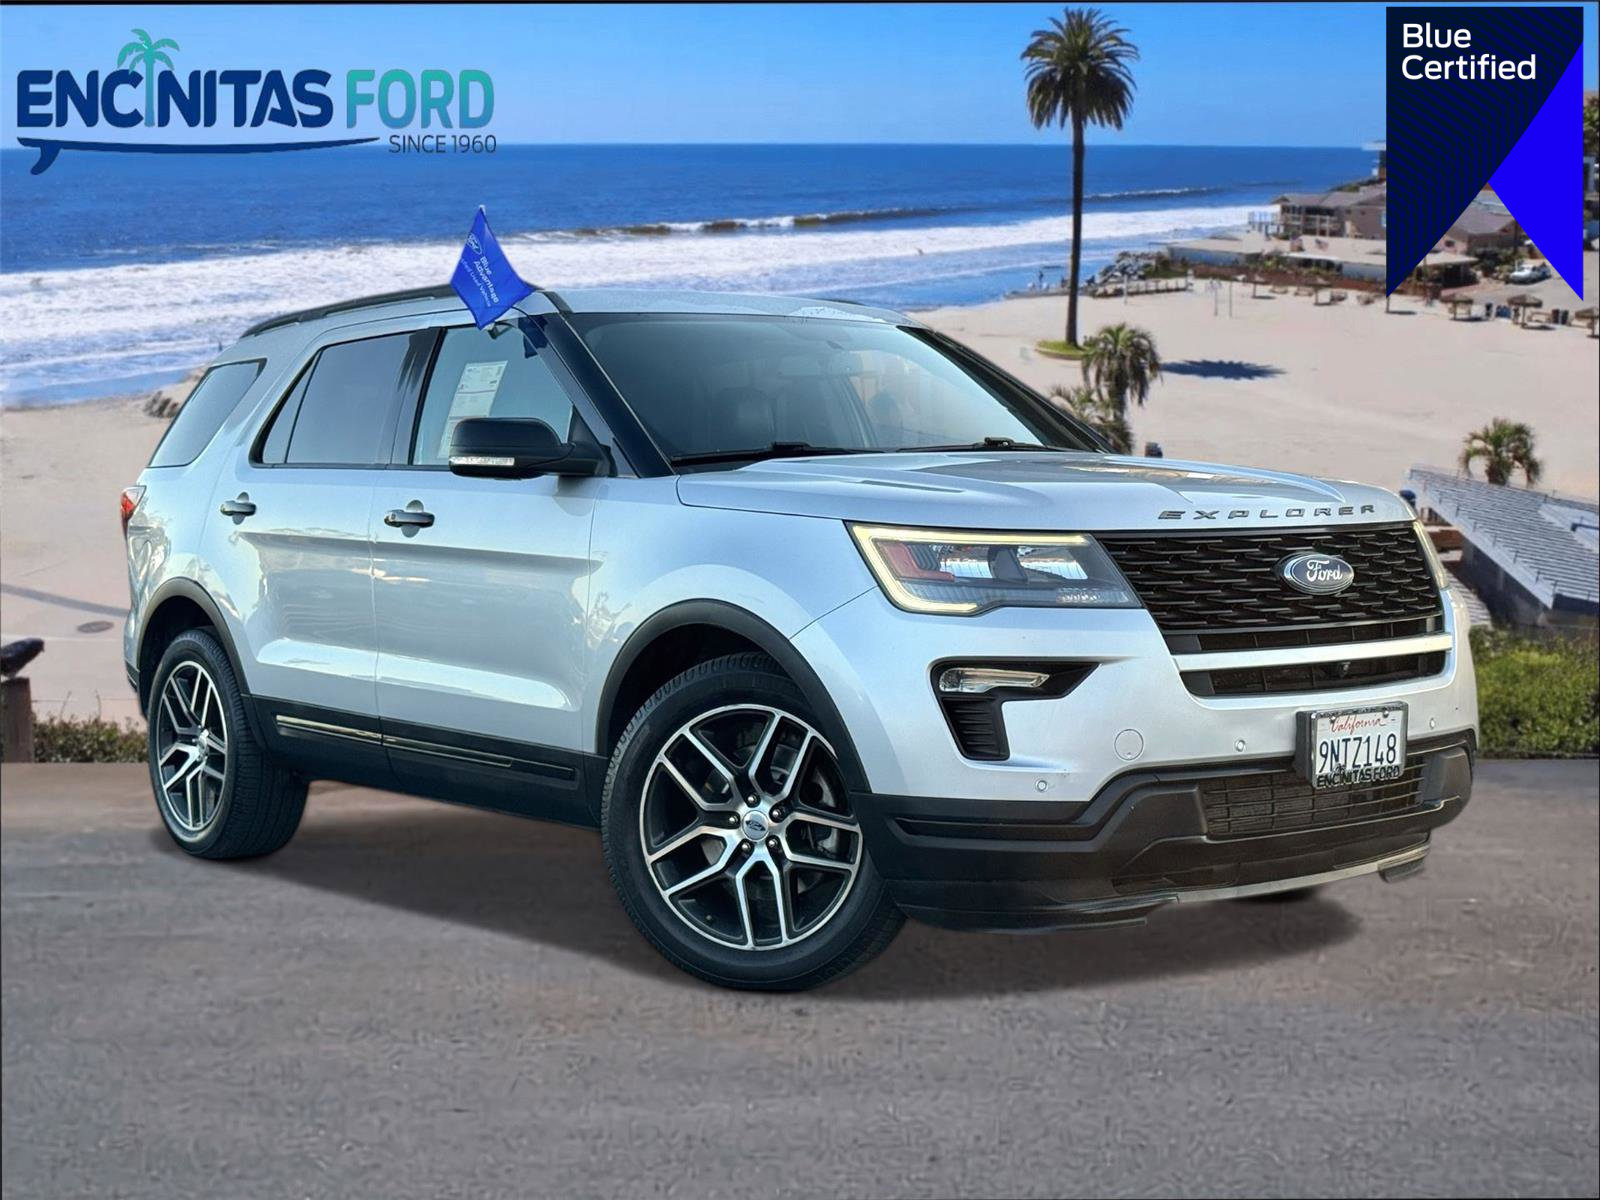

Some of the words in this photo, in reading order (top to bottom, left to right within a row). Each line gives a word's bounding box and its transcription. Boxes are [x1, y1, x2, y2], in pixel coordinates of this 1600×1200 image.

[480, 256, 492, 276] Blue
[474, 261, 499, 304] Advantage
[1157, 504, 1375, 520] EXPLORER
[1306, 559, 1343, 582] Ford
[1331, 714, 1386, 735] California
[1318, 733, 1397, 773] 9NTZ148
[1316, 766, 1373, 788] ENCINITAS
[1373, 765, 1400, 782] FORD
